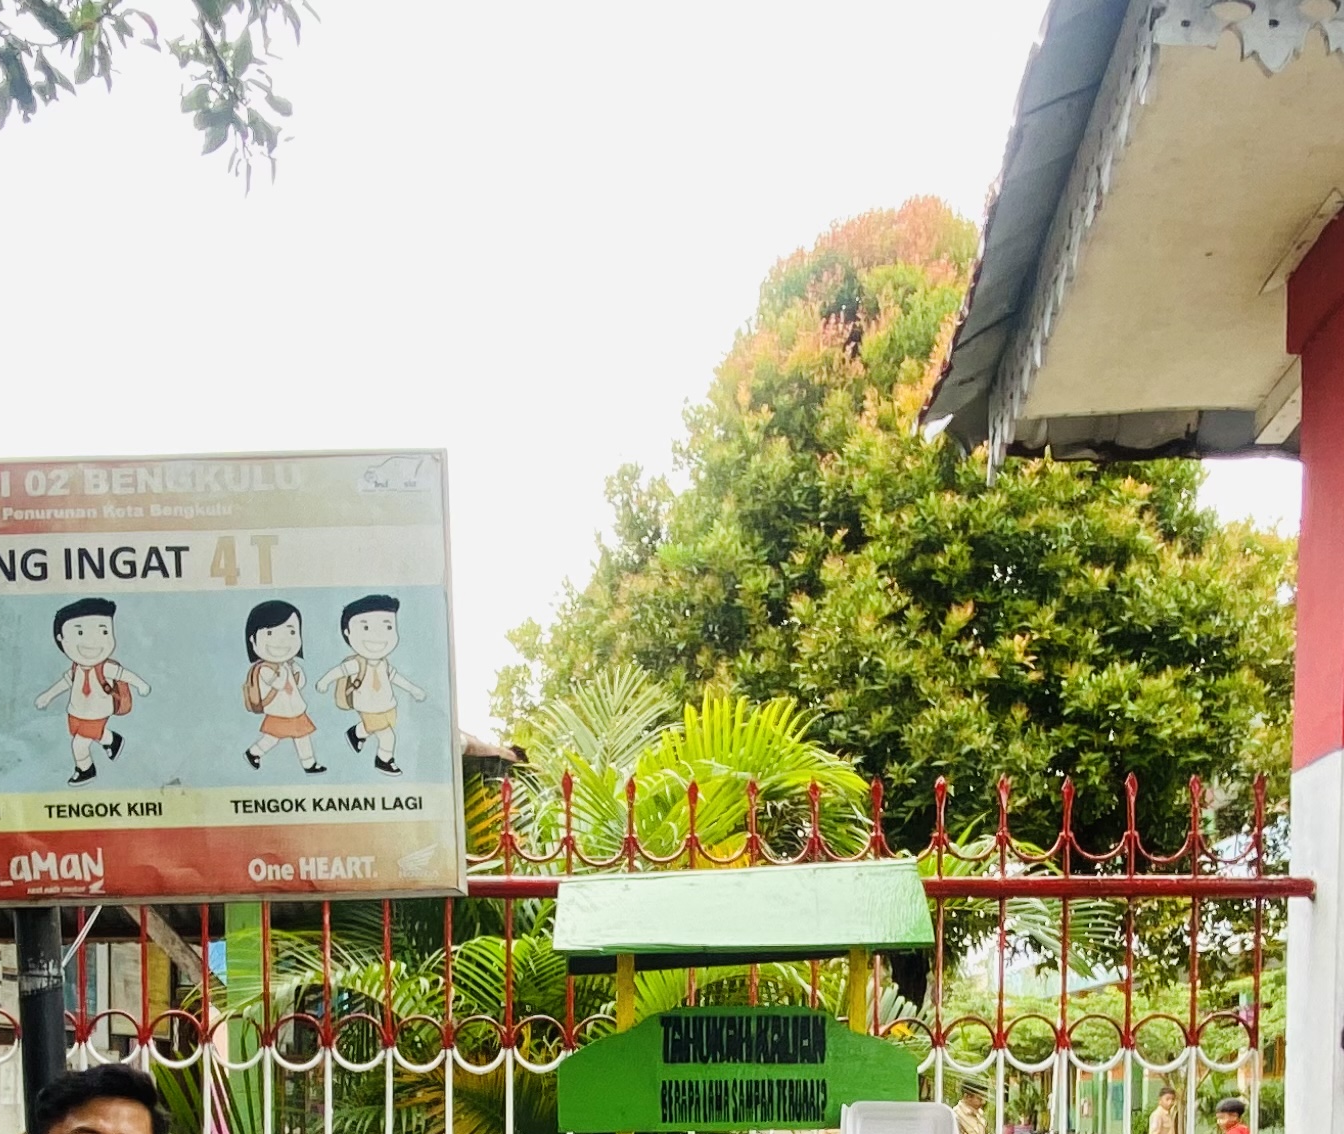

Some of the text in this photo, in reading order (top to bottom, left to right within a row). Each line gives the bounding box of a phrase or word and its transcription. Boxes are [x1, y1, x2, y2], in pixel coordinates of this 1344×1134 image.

[24, 467, 72, 497] 02
[83, 463, 305, 496] BENGKULU
[2, 507, 98, 522] Penurunan
[105, 505, 145, 519] Kota
[150, 504, 233, 520] Bengkulu
[64, 545, 191, 580] INGAT
[45, 801, 163, 819] TENGOK KIRI
[230, 796, 424, 815] TENGOK KANAN LAGI
[248, 858, 295, 882] One
[660, 1015, 827, 1064] TAHUKAH KALIAN
[661, 1079, 701, 1124] BERAPA
[703, 1079, 730, 1123] LAMA
[732, 1078, 774, 1123] SAMPAH
